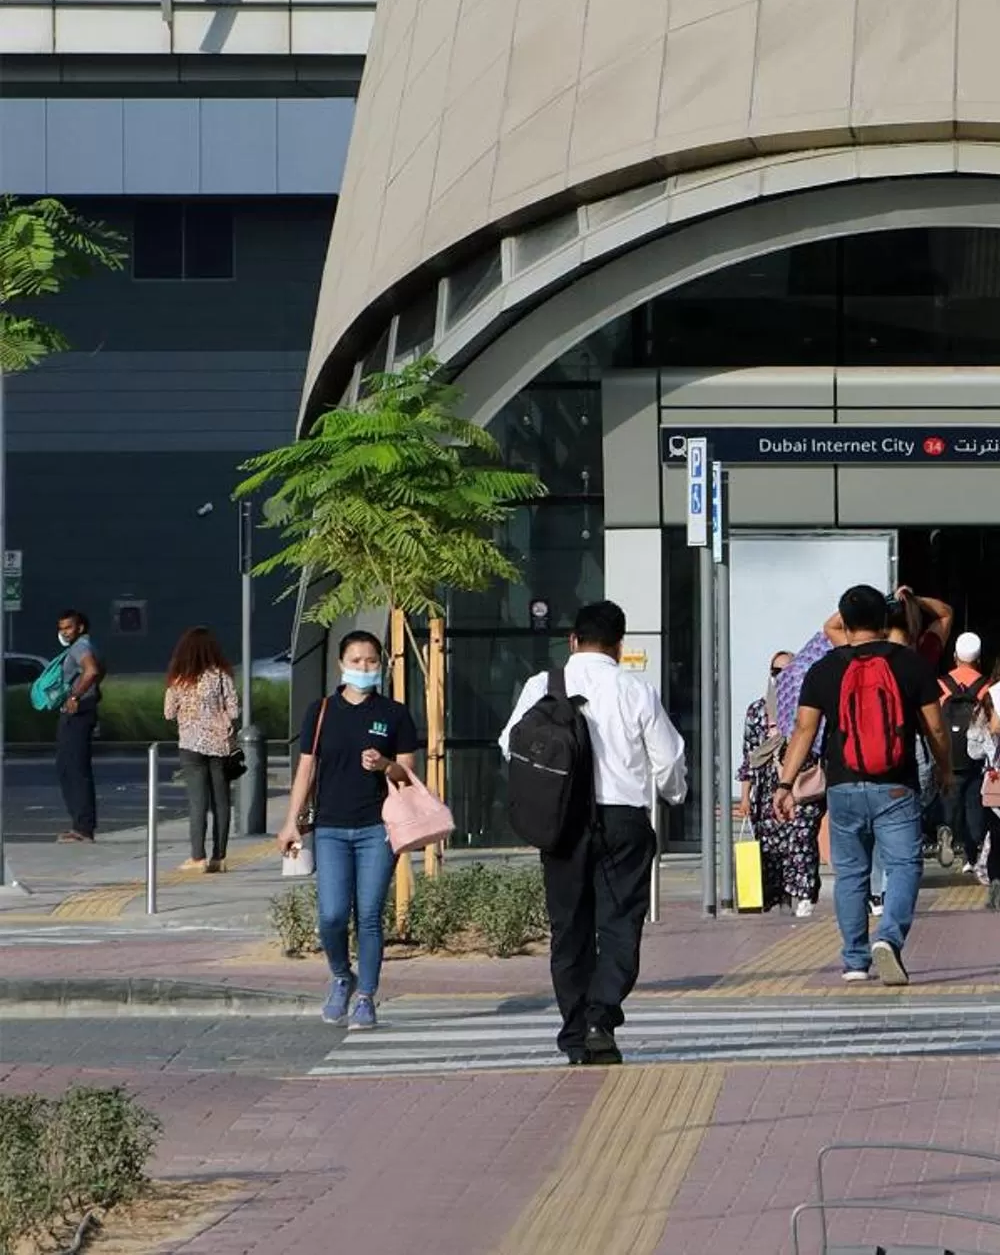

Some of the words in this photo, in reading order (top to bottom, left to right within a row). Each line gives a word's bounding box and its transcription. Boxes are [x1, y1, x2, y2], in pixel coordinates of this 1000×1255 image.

[759, 438, 807, 453] Dubai
[811, 438, 878, 453] Internet
[881, 438, 915, 456] City
